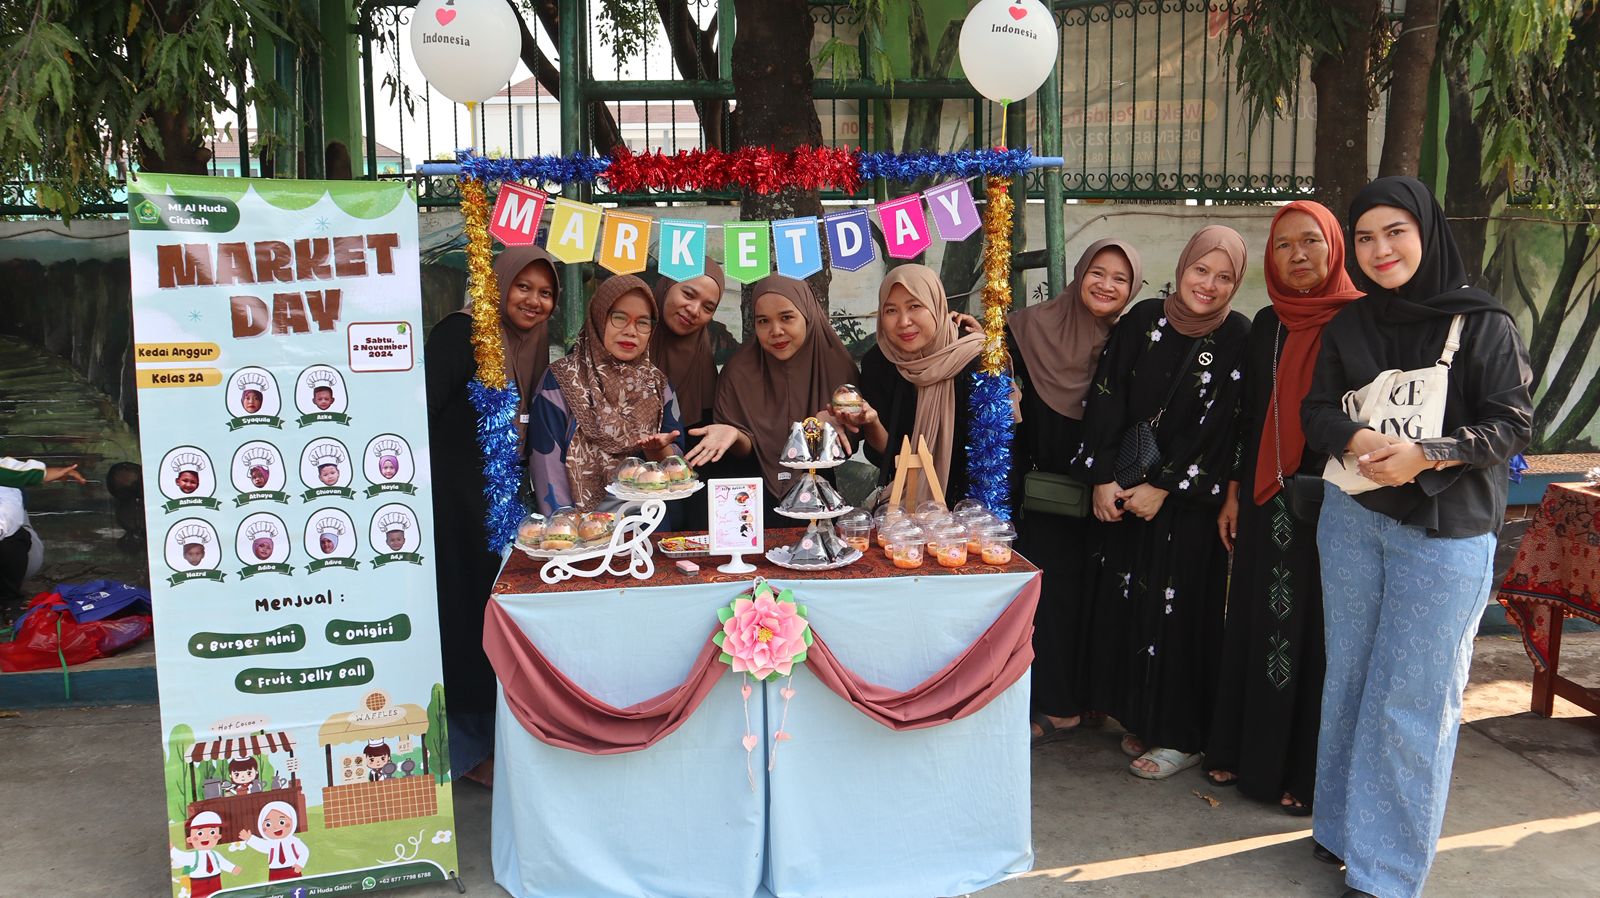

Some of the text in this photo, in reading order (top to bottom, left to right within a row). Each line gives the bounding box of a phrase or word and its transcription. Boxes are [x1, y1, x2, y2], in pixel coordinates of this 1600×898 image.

[423, 32, 471, 47] Indonesia
[991, 24, 1038, 40] Indonesia
[168, 203, 227, 213] MI Al Huda
[169, 215, 209, 226] Citatah
[157, 232, 401, 290] MARKET
[229, 289, 344, 340] DAY
[138, 346, 213, 358] Kedai Anggur
[151, 372, 204, 384] Kelas 2A
[345, 622, 394, 640] Onigiri
[210, 630, 296, 652] Burger Mini
[258, 664, 366, 689] Fruit Jelly Ball
[356, 709, 398, 722] WAFFLES
[317, 886, 333, 894] Huda
